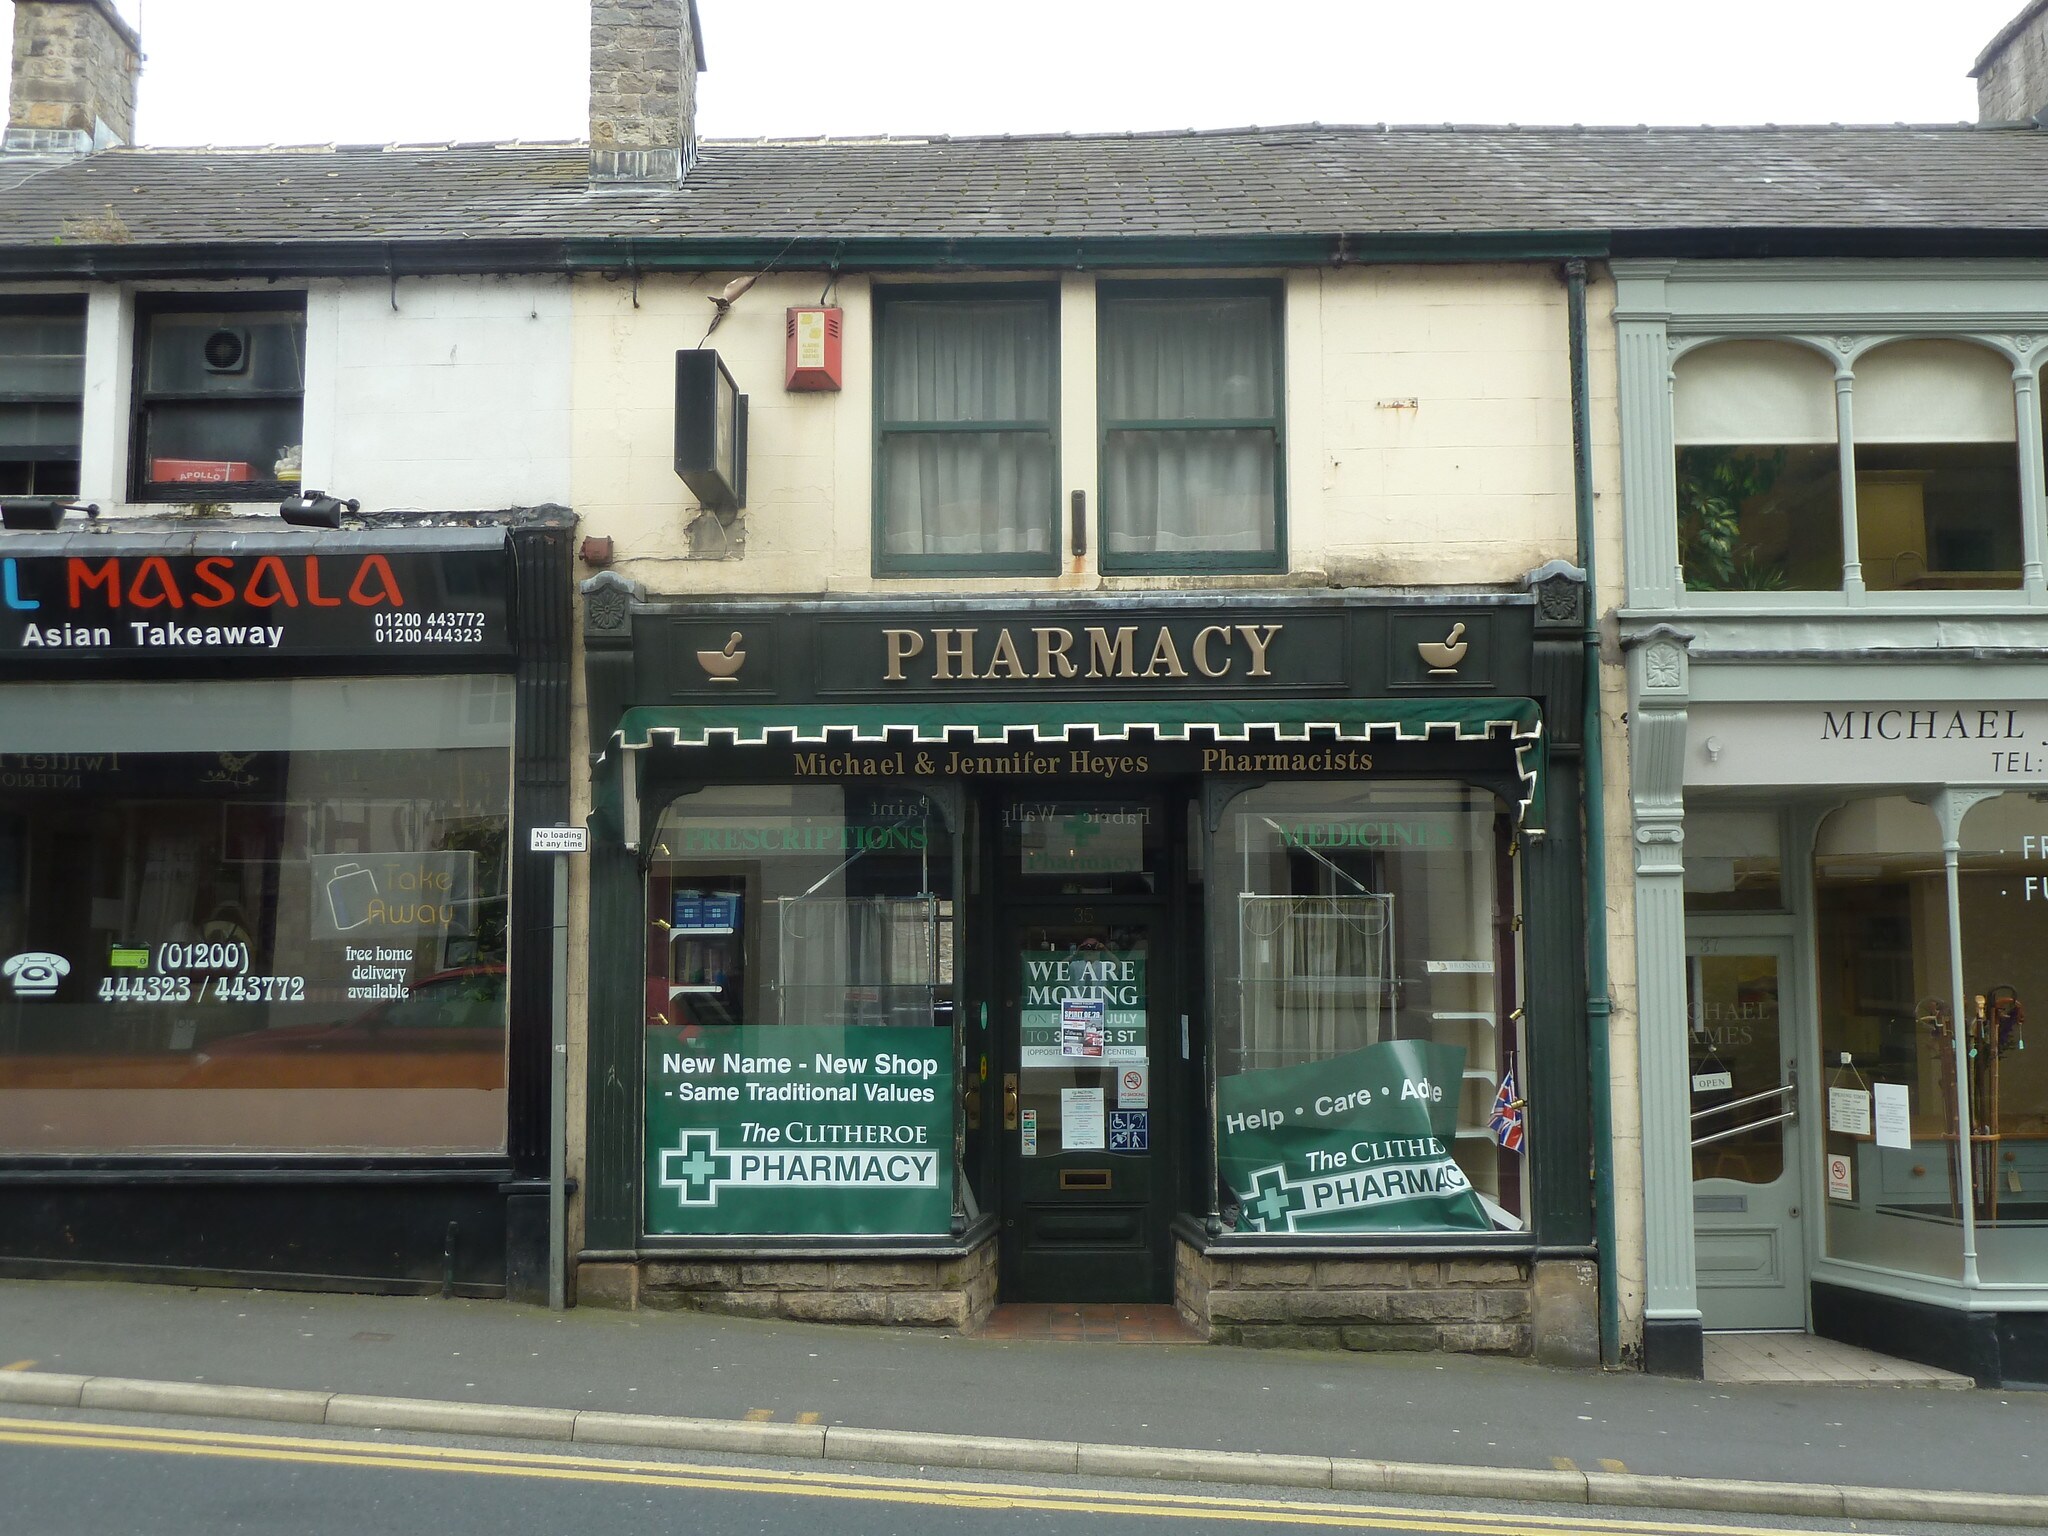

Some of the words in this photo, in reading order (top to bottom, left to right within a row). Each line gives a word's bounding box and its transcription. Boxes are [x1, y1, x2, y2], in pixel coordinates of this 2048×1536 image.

[180, 471, 220, 481] APOLLO
[68, 554, 404, 608] MASALA
[375, 613, 421, 627] 01200
[427, 612, 485, 627] 443772
[23, 623, 111, 647] Asian
[131, 621, 284, 648] Takeaway
[376, 629, 422, 643] 01200
[424, 629, 483, 643] 444323
[882, 624, 1284, 681] PHARMACY
[1820, 710, 2025, 740] MICHAEL
[793, 752, 904, 776] Michael
[914, 752, 935, 775] &
[945, 751, 1061, 775] Jennifer
[1070, 751, 1149, 779] Heyes
[1201, 748, 1374, 773] Pharmacists
[1991, 752, 2043, 773] TEL:
[551, 831, 582, 839] loading
[686, 826, 929, 851] PRESCRIPTIONS
[1276, 822, 1456, 848] MEDICINES
[383, 864, 452, 890] Take
[366, 899, 455, 930] Away
[1073, 907, 1094, 923] 35
[157, 942, 249, 974] (01200)
[346, 946, 372, 961] free
[376, 946, 413, 961] home
[352, 965, 406, 983] delivery
[1028, 961, 1071, 981] WE
[1080, 960, 1136, 981] ARE
[99, 976, 191, 1002] 444323
[197, 975, 209, 1003] /
[214, 976, 305, 1001] 443772
[348, 984, 409, 999] available
[1027, 985, 1139, 1006] MOVING
[1027, 1014, 1047, 1024] ON
[1106, 1013, 1138, 1024] JULY
[1026, 1030, 1049, 1040] TO
[1117, 1030, 1137, 1043] ST
[663, 1053, 715, 1074] New
[723, 1053, 791, 1074] Name
[815, 1053, 867, 1074] New
[875, 1053, 938, 1079] Shop
[679, 1082, 739, 1101] Same
[745, 1082, 857, 1102] Traditional
[864, 1082, 935, 1102] Values
[1698, 1078, 1726, 1088] OPEN
[1226, 1108, 1284, 1134] Help
[1314, 1087, 1371, 1117] Care
[740, 1122, 780, 1142] The
[785, 1122, 928, 1144] CLITHEROE
[740, 1155, 933, 1182] PHARMACY
[1305, 1150, 1347, 1172] The
